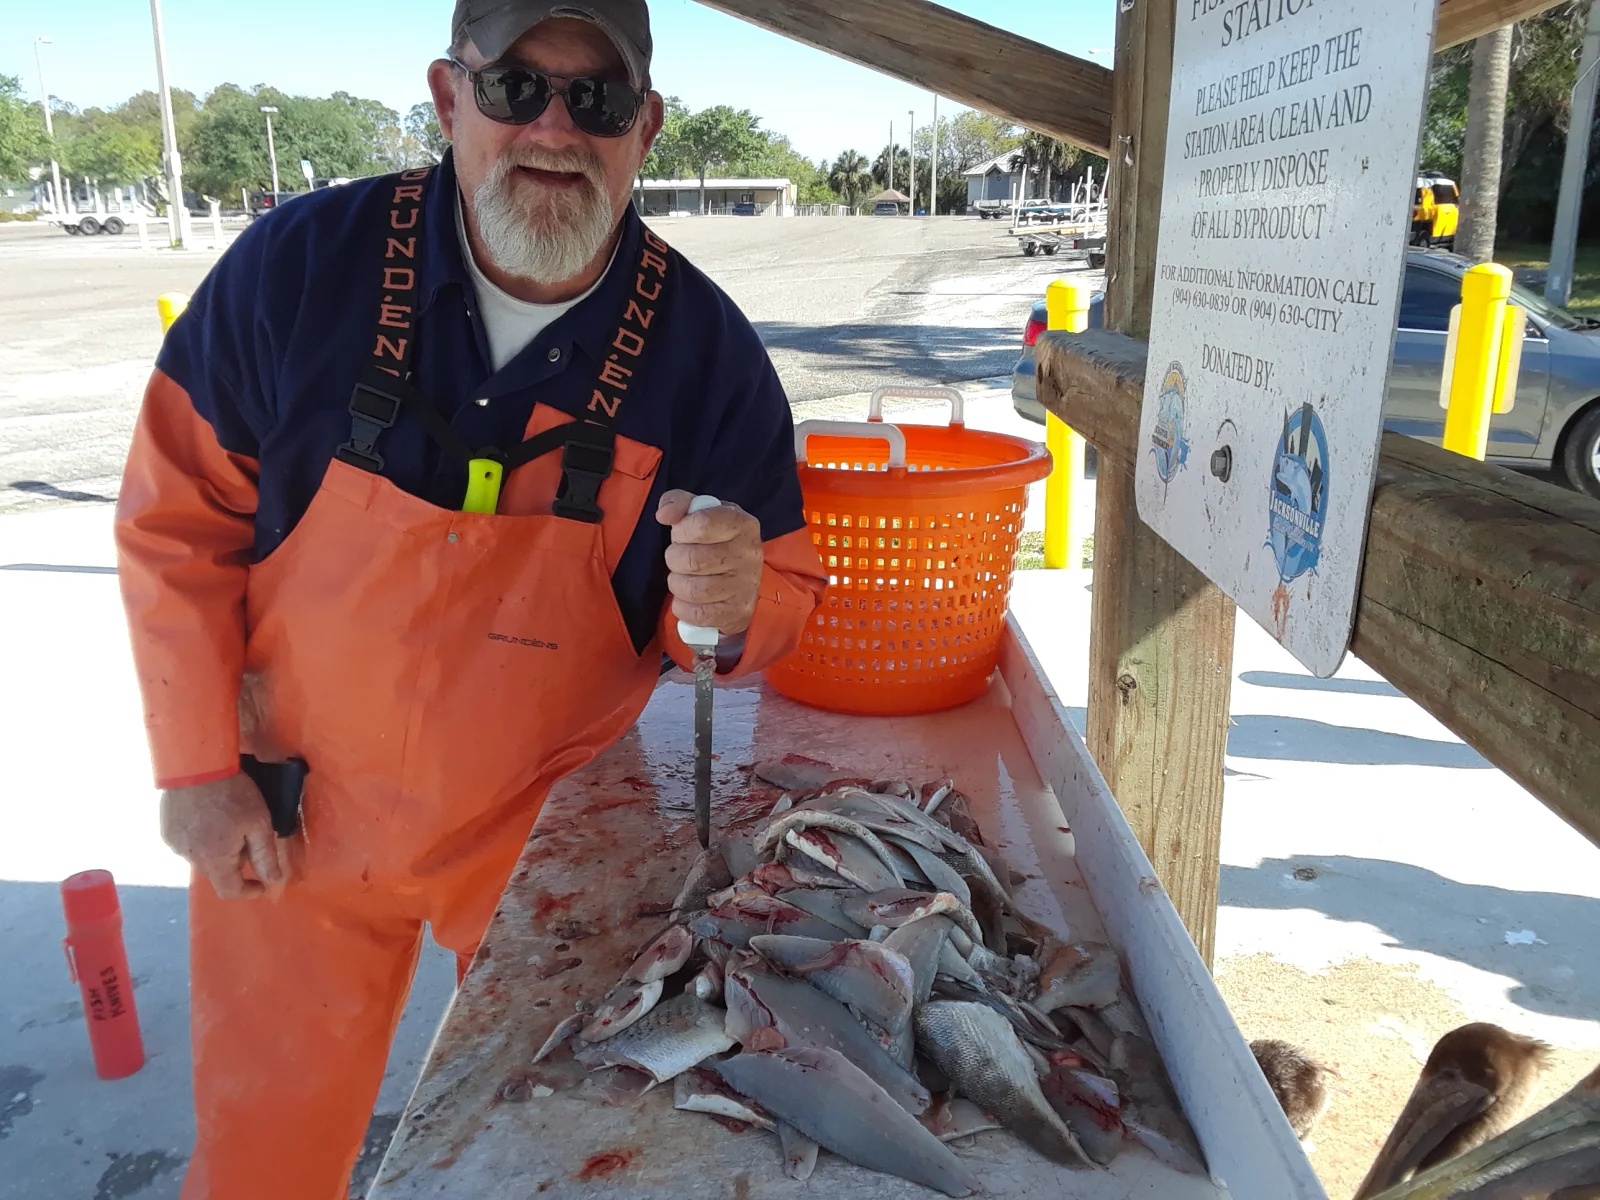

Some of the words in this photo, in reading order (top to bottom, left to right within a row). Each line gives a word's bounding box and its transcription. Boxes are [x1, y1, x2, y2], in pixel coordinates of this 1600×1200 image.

[1221, 0, 1314, 48] STATI
[1195, 73, 1238, 117] PLEASE
[1239, 61, 1275, 102] HELP
[1277, 43, 1320, 91] KEEP
[1324, 28, 1363, 76] THE
[1184, 121, 1230, 160] STATION
[1230, 111, 1266, 150] AREA
[1269, 94, 1327, 142] CLEAN
[1326, 83, 1372, 130] AND
[1198, 159, 1261, 198] PROPERLY
[1262, 148, 1330, 192] DISPOSE
[1192, 211, 1208, 239] OF
[1208, 209, 1231, 239] ALL
[1160, 264, 1177, 281] FOR
[1177, 264, 1234, 289] ADDITIONAL
[1237, 269, 1331, 301] INFORMATION
[1332, 279, 1380, 306] CALL
[1172, 287, 1192, 311] (904)
[1192, 290, 1230, 313] 630-0839
[1231, 296, 1247, 316] OR
[1249, 298, 1276, 326] (904)
[1279, 303, 1343, 333] 630-CITY
[1201, 343, 1253, 384] DONATED
[1253, 358, 1275, 393] BY:
[1269, 489, 1321, 539] JACKSONVILLE
